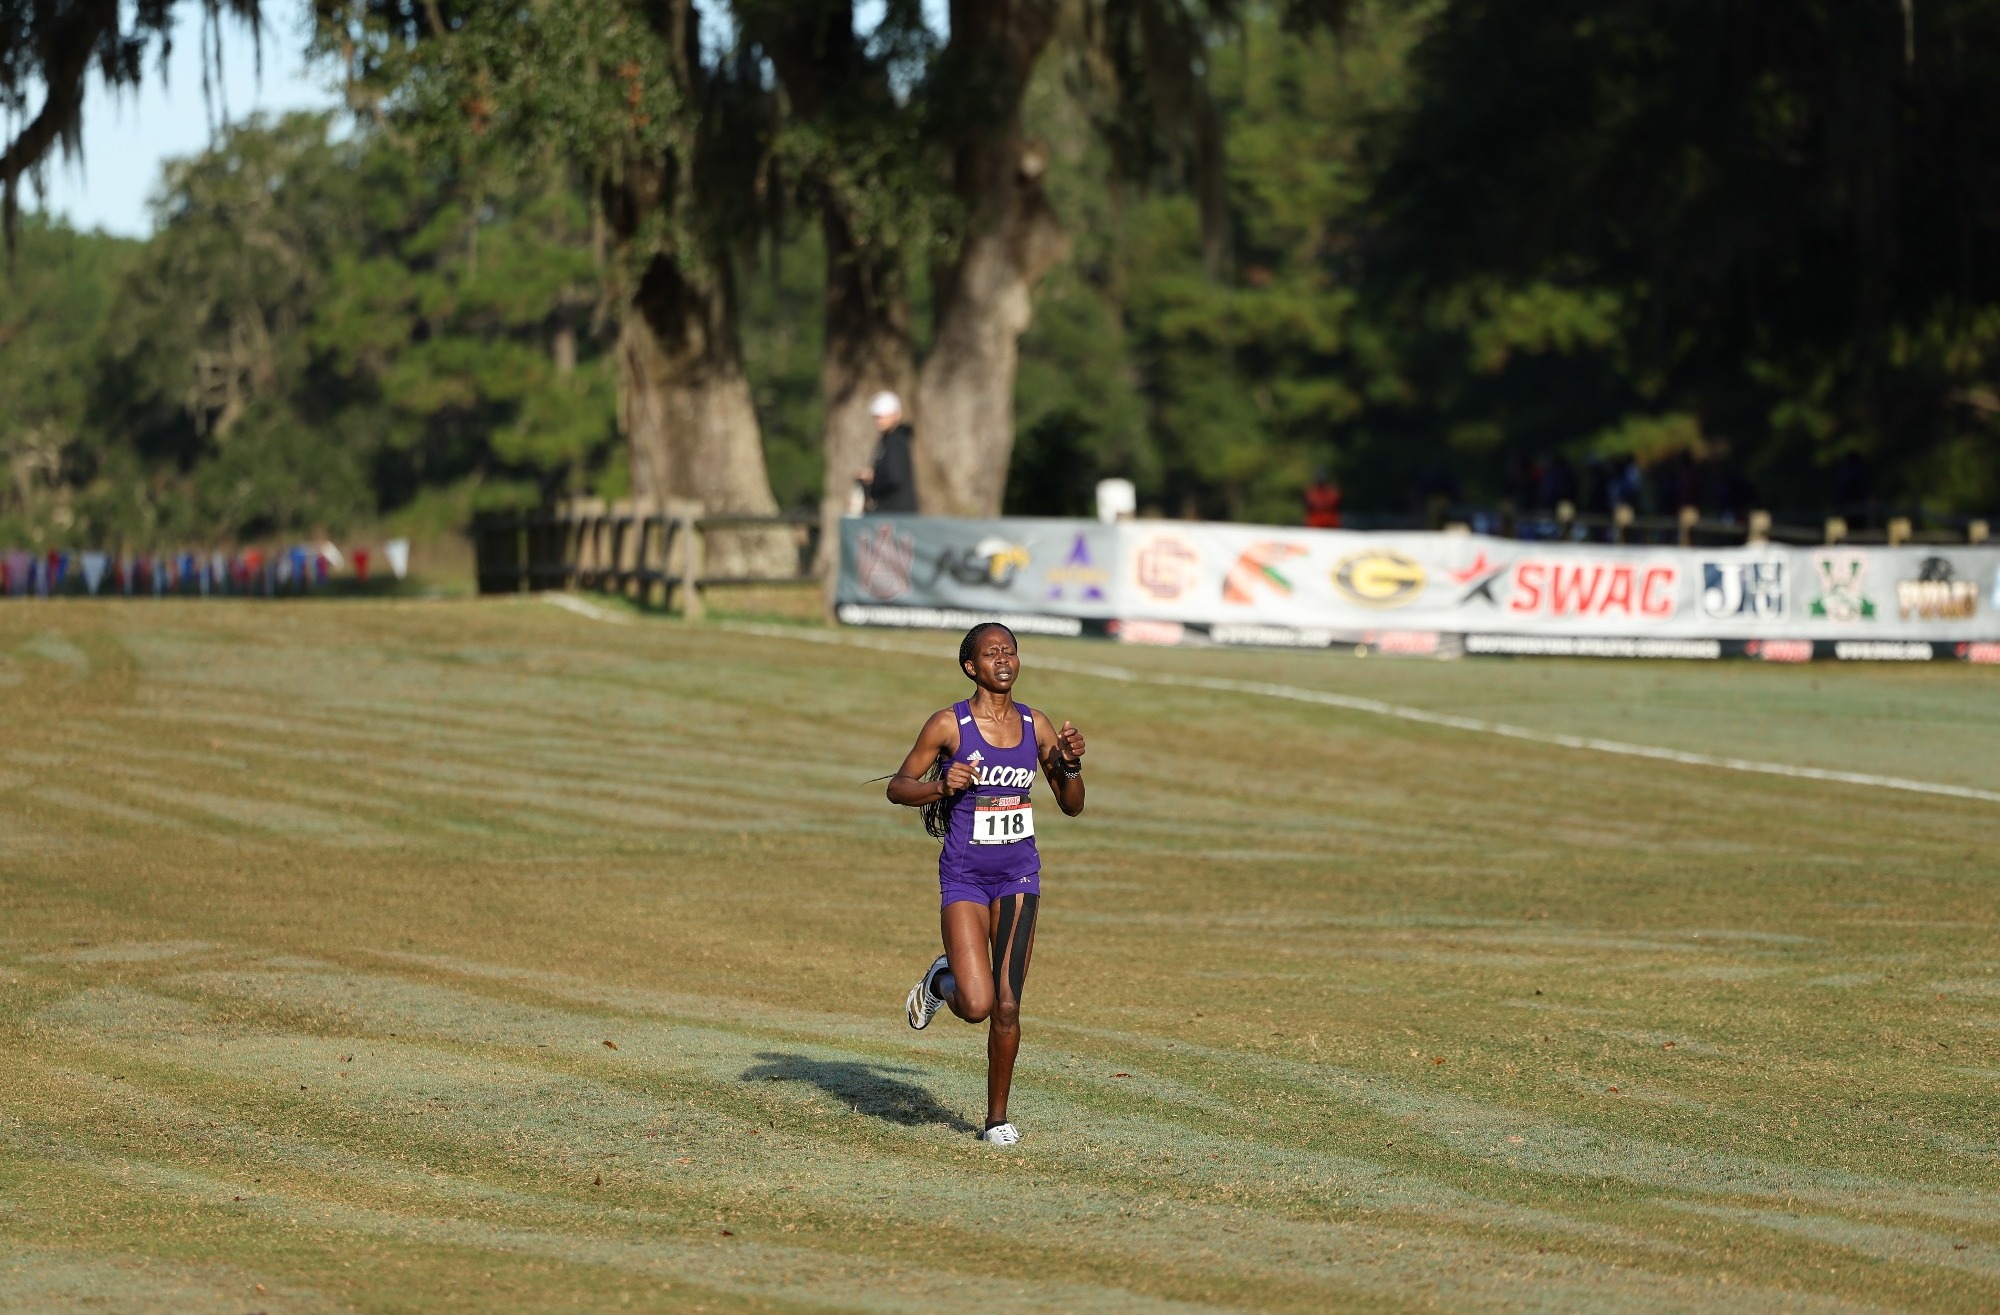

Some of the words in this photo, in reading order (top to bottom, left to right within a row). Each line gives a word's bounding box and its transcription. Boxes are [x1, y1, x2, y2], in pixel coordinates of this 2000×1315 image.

[1511, 562, 1675, 616] SWAC
[999, 797, 1020, 806] SWAC
[986, 813, 1024, 835] 118
